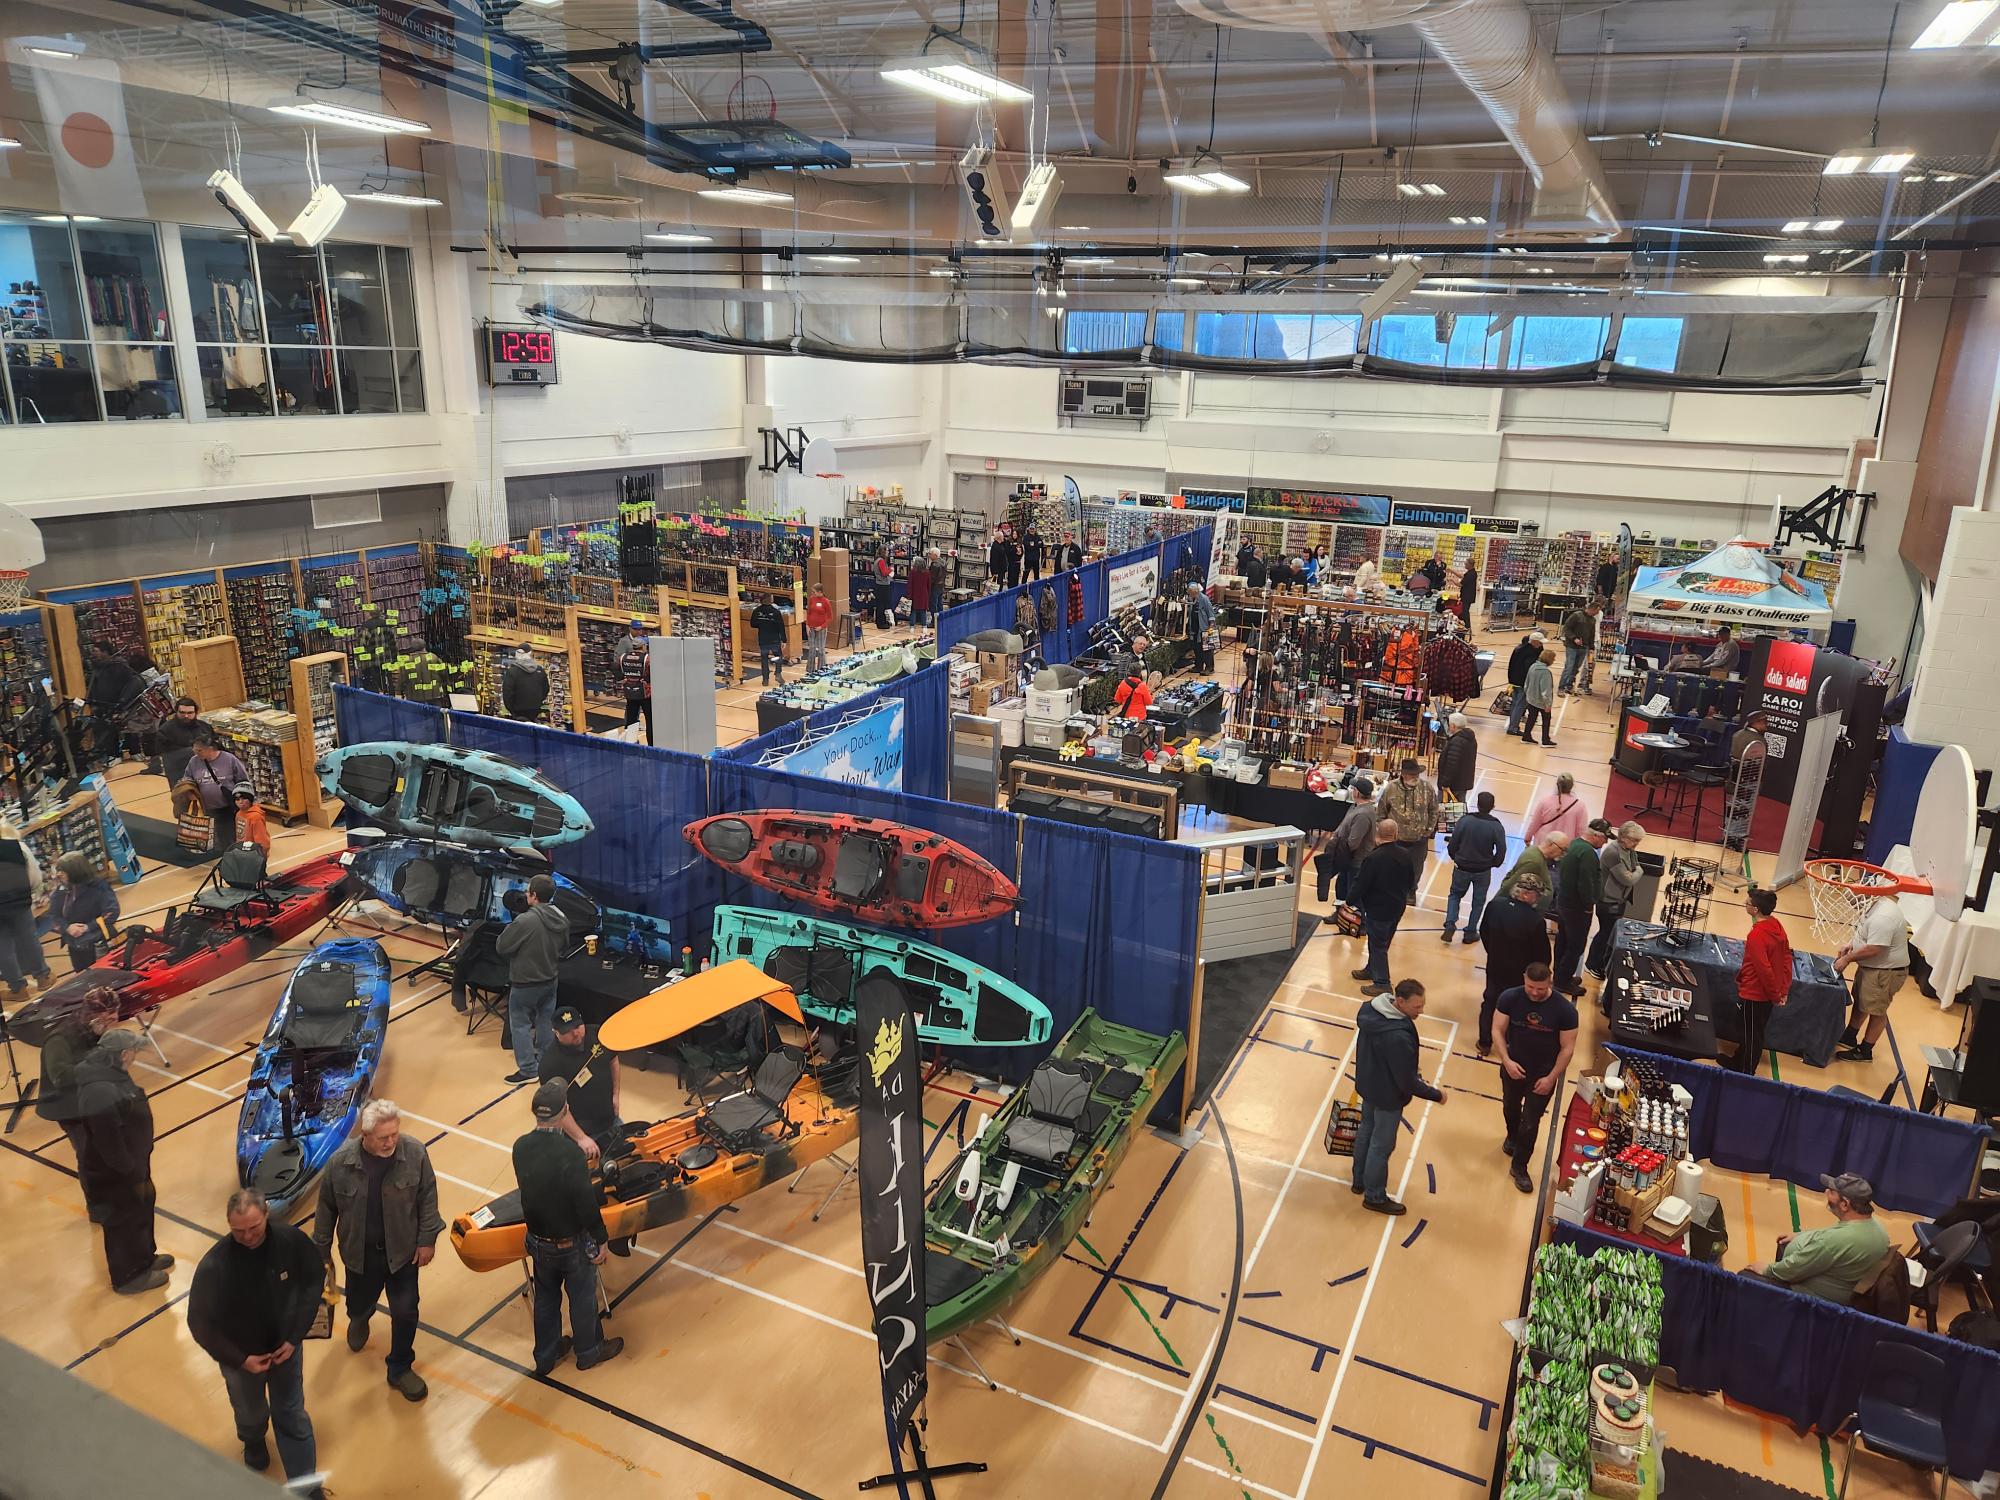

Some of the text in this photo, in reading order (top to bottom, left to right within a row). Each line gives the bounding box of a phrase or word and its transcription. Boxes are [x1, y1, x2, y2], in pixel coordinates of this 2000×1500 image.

[502, 332, 553, 363] 12:58
[1067, 380, 1082, 389] Home
[1184, 493, 1244, 509] SHIMANO
[1309, 495, 1360, 508] TACKLE
[1394, 508, 1467, 524] SHIMANO
[1472, 518, 1519, 527] STREAMSIDE
[1690, 602, 1712, 614] Big
[1713, 604, 1745, 616] Bass
[1746, 608, 1810, 622] Challenge
[1767, 667, 1807, 691] data safaris
[1763, 693, 1803, 710] KAROI
[1781, 706, 1801, 716] LODGE
[1766, 714, 1799, 728] MPOPO
[1777, 724, 1797, 734] AFRICA
[824, 727, 882, 766] Your Dock...
